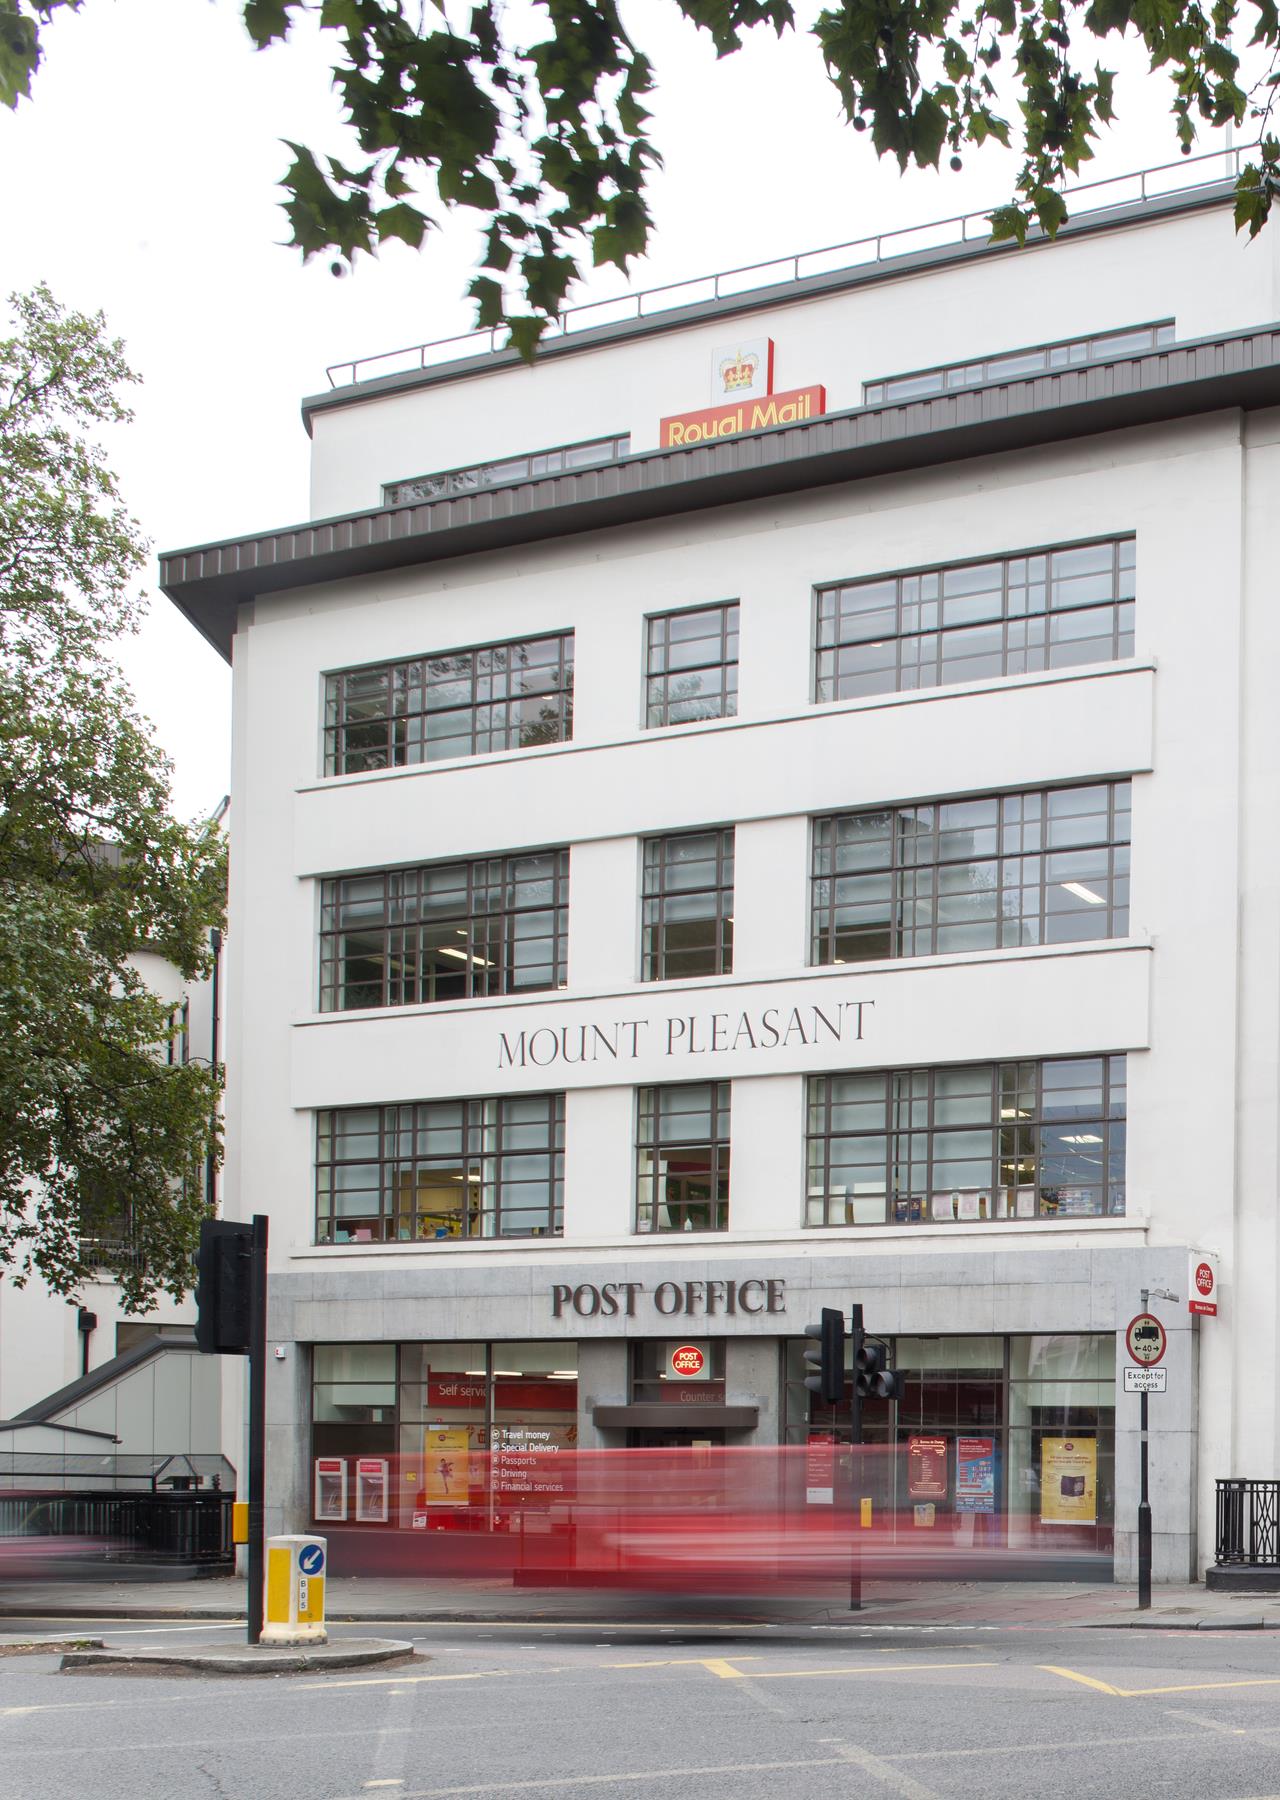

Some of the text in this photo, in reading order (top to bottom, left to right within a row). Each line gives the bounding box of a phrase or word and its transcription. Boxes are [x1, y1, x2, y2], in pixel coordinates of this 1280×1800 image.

[668, 394, 811, 447] Royal Mail
[497, 1000, 875, 1069] MOUNT PLEASANT
[1199, 1269, 1210, 1279] POST
[1197, 1278, 1212, 1288] OFFICE
[551, 1278, 786, 1318] POST OFFICE
[679, 1352, 698, 1361] POST
[675, 1360, 701, 1370] OFFICE
[1127, 1371, 1164, 1380] Except for
[439, 1383, 486, 1397] Self servic
[1134, 1381, 1158, 1389] access
[680, 1390, 714, 1402] Counter
[501, 1429, 551, 1441] Travel money
[501, 1442, 559, 1454] Special Delivery
[501, 1455, 537, 1466] Passports
[501, 1468, 527, 1480] Driving
[501, 1481, 564, 1492] Financial services
